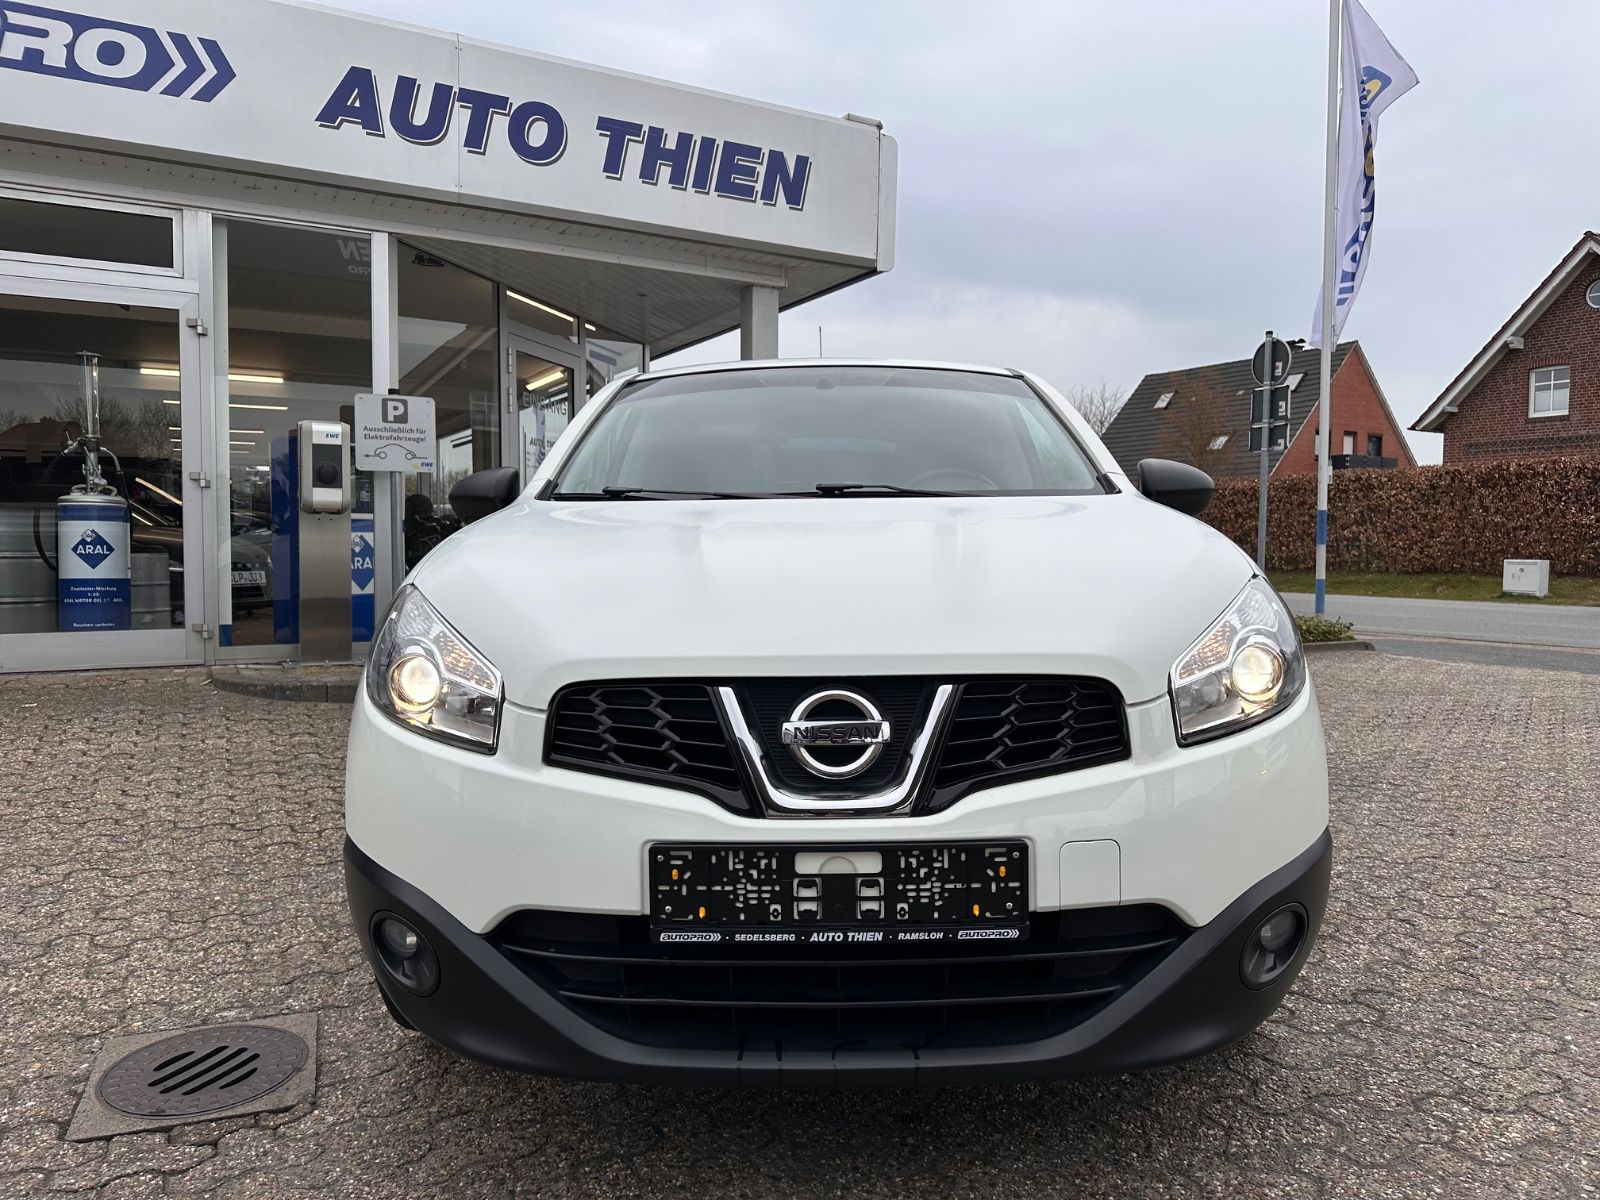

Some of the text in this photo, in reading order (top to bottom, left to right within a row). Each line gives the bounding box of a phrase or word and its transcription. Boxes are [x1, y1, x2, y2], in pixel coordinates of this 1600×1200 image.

[0, 9, 147, 79] RO
[315, 65, 812, 212] AUTO THIEN
[363, 425, 427, 435] Ausschließlich für
[364, 433, 427, 443] Elektrofahrzeuge!
[76, 544, 110, 554] ARAL
[793, 726, 880, 741] NISSAN
[734, 933, 796, 942] SEDELSBERG
[809, 932, 843, 942] AUTO
[846, 931, 884, 942] THIEN
[898, 932, 944, 940] RAMSLOH
